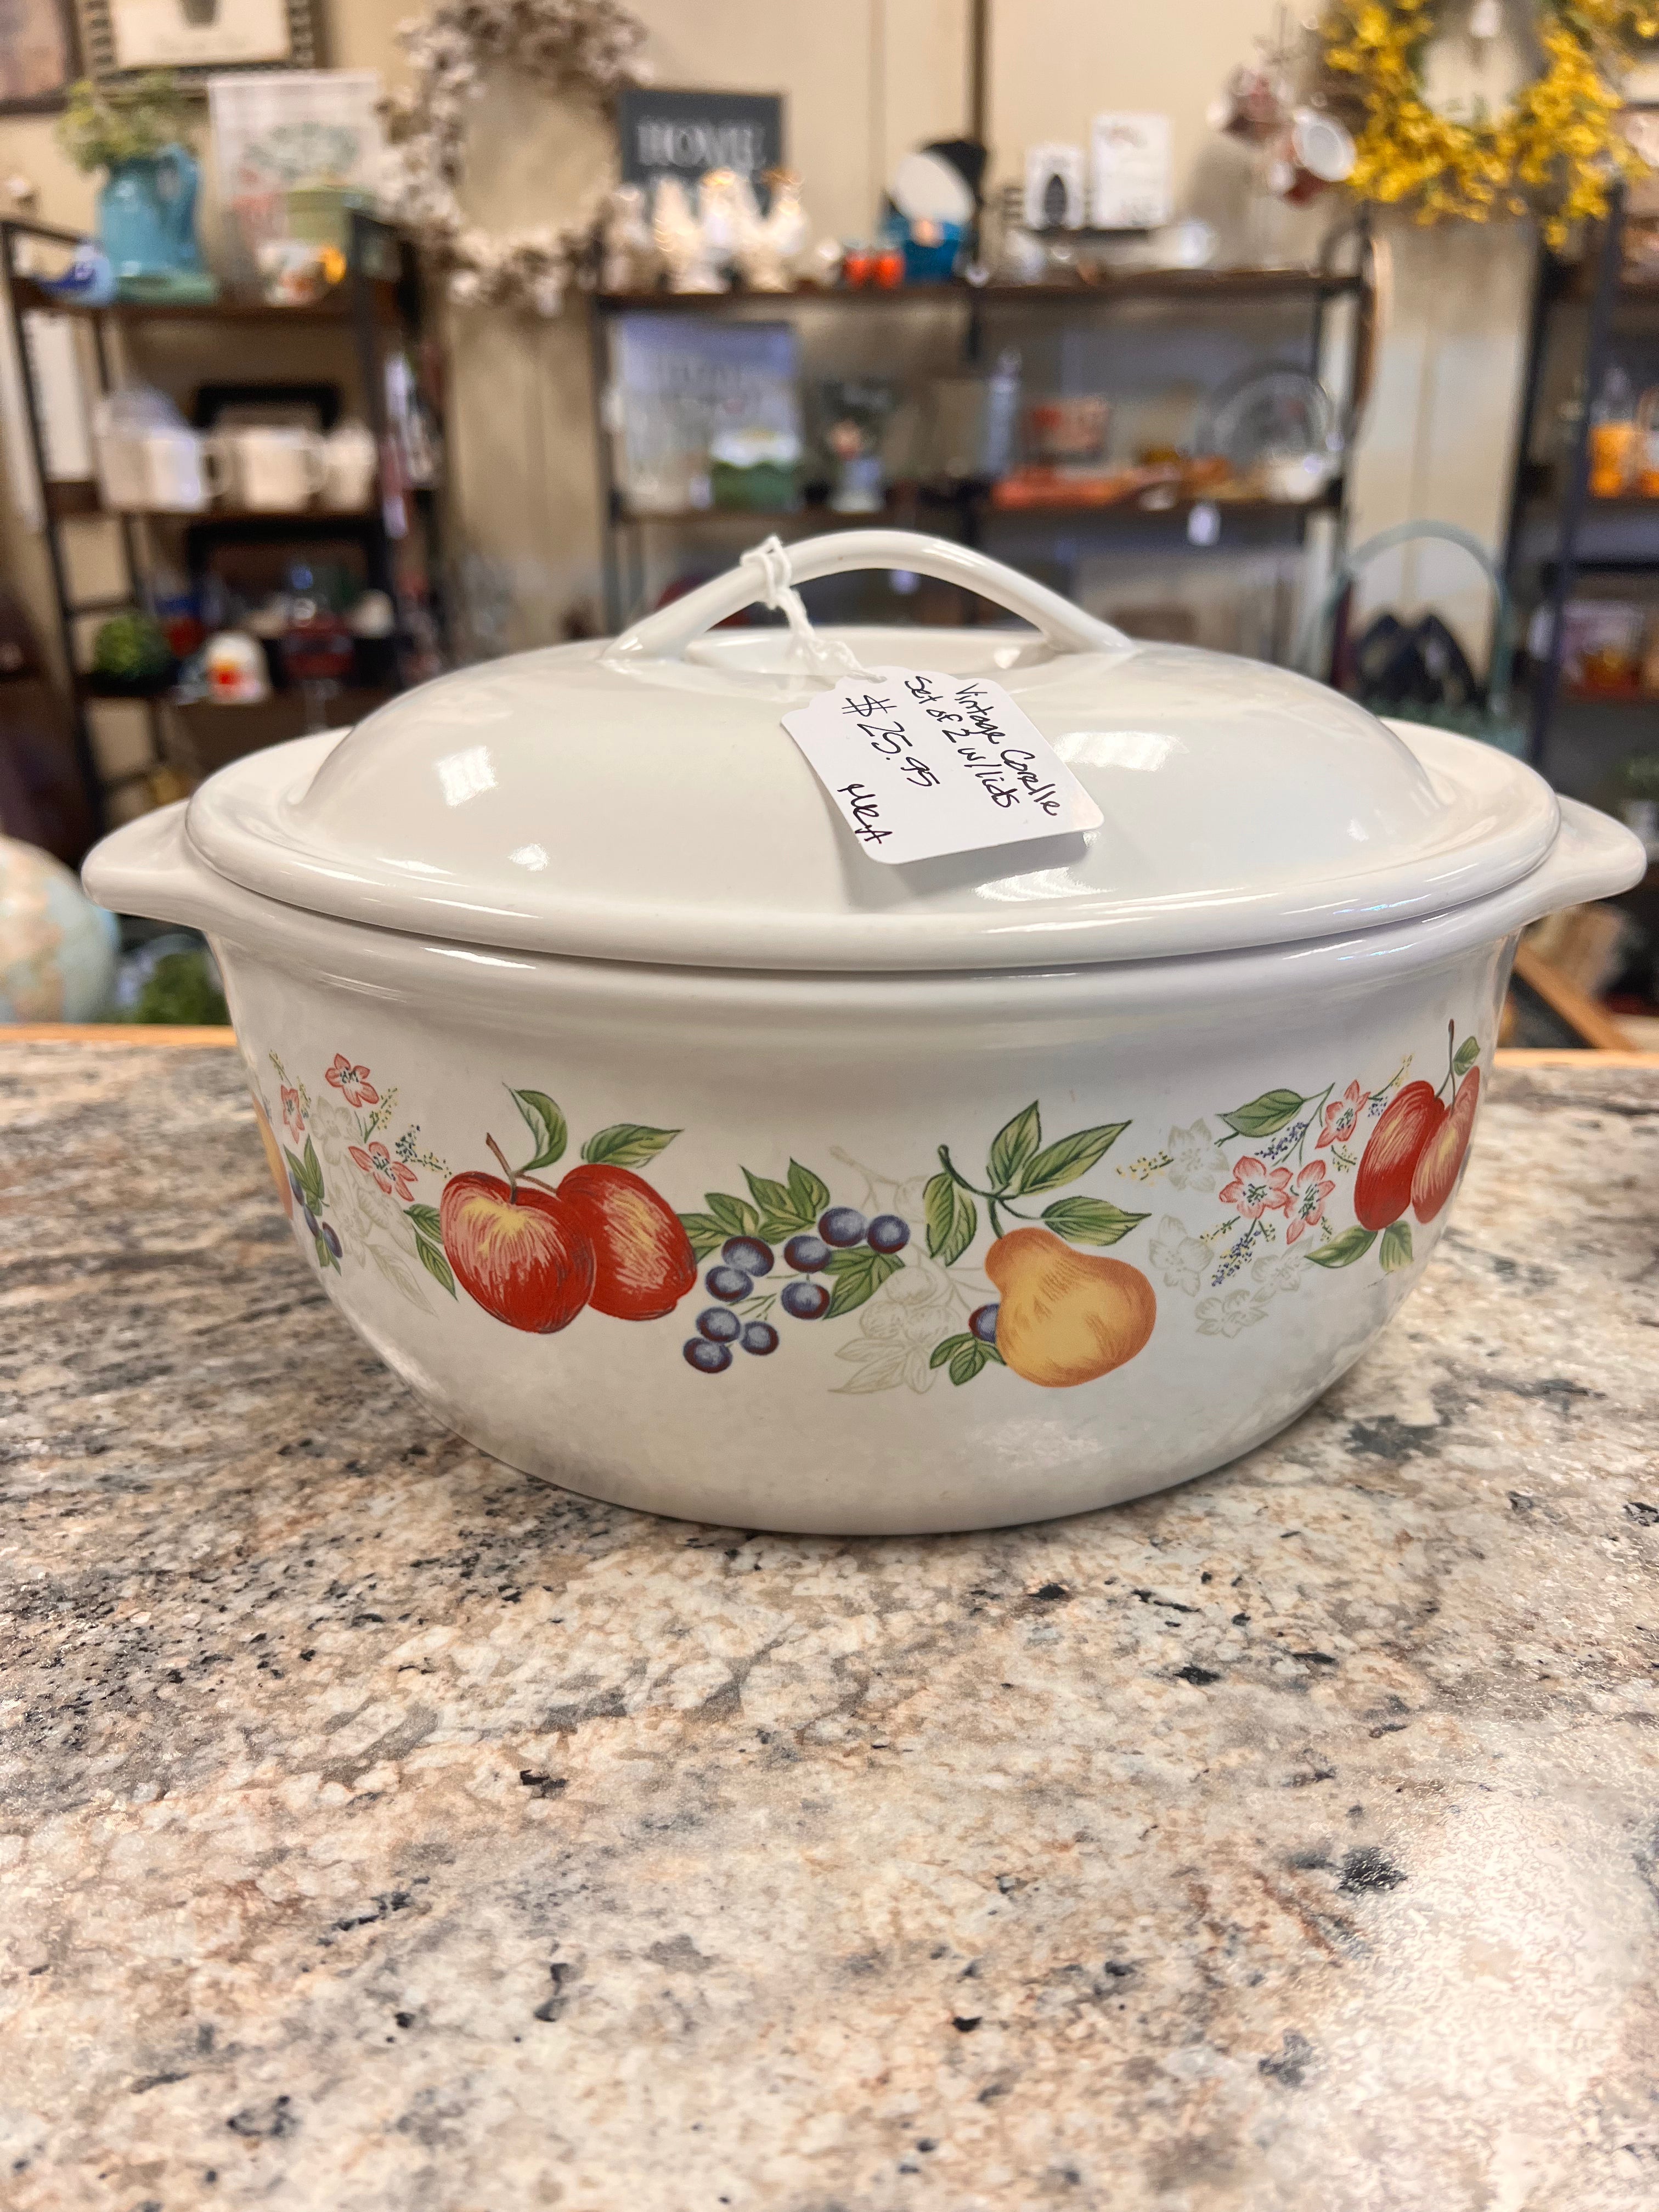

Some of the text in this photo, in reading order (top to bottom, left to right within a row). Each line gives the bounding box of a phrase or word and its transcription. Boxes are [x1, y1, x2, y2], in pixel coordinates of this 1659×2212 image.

[904, 675, 944, 705] Set
[926, 709, 964, 723] of
[954, 682, 1006, 745] Vintage
[841, 694, 941, 787] $25.95
[941, 728, 970, 743] 2
